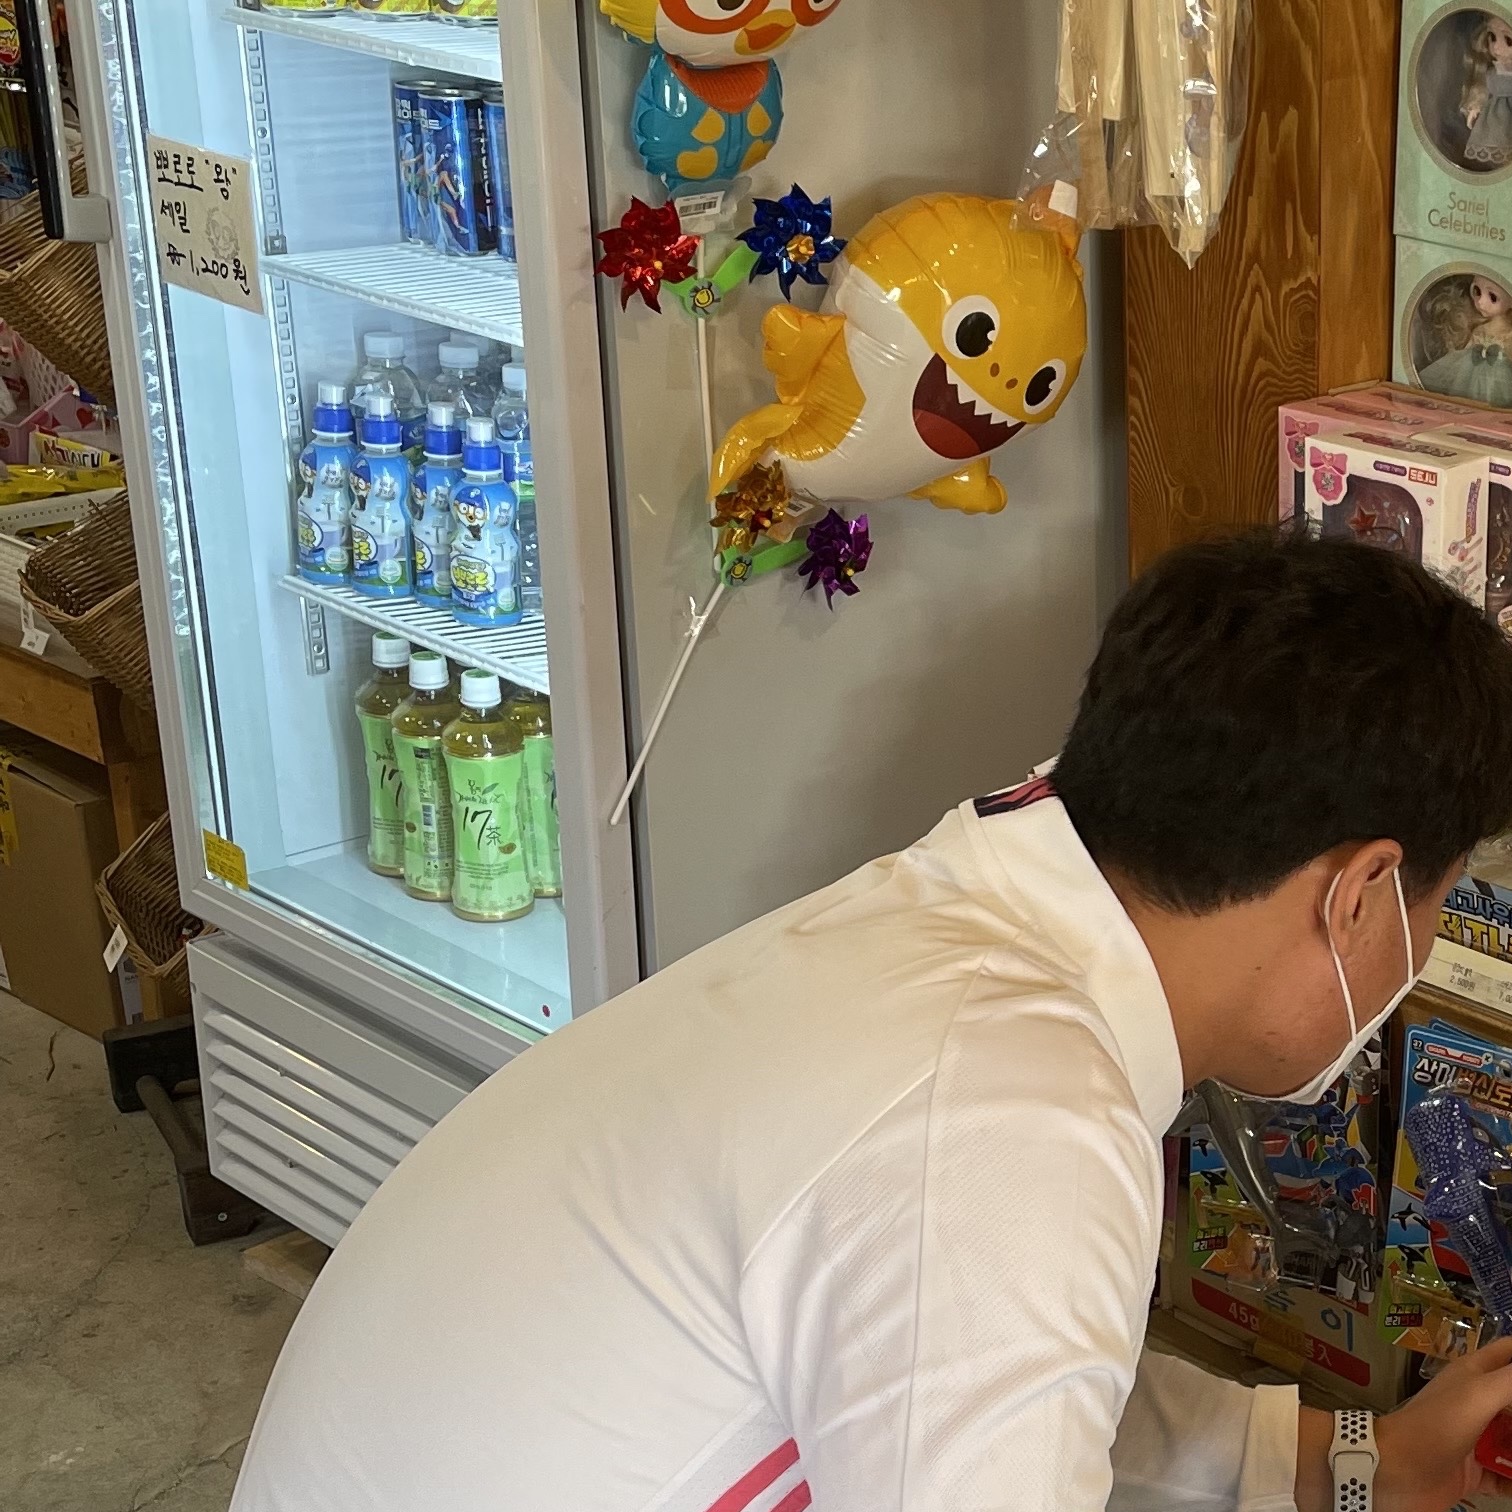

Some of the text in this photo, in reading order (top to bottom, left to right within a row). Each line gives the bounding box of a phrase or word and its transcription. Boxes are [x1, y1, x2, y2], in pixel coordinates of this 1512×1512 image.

[153, 149, 204, 193] 뽀로로
[160, 198, 191, 234] 세일
[1448, 190, 1490, 216] Sariel
[1427, 209, 1506, 242] Celebrities
[1409, 467, 1439, 487] SEJU
[1228, 1302, 1261, 1332] 45g
